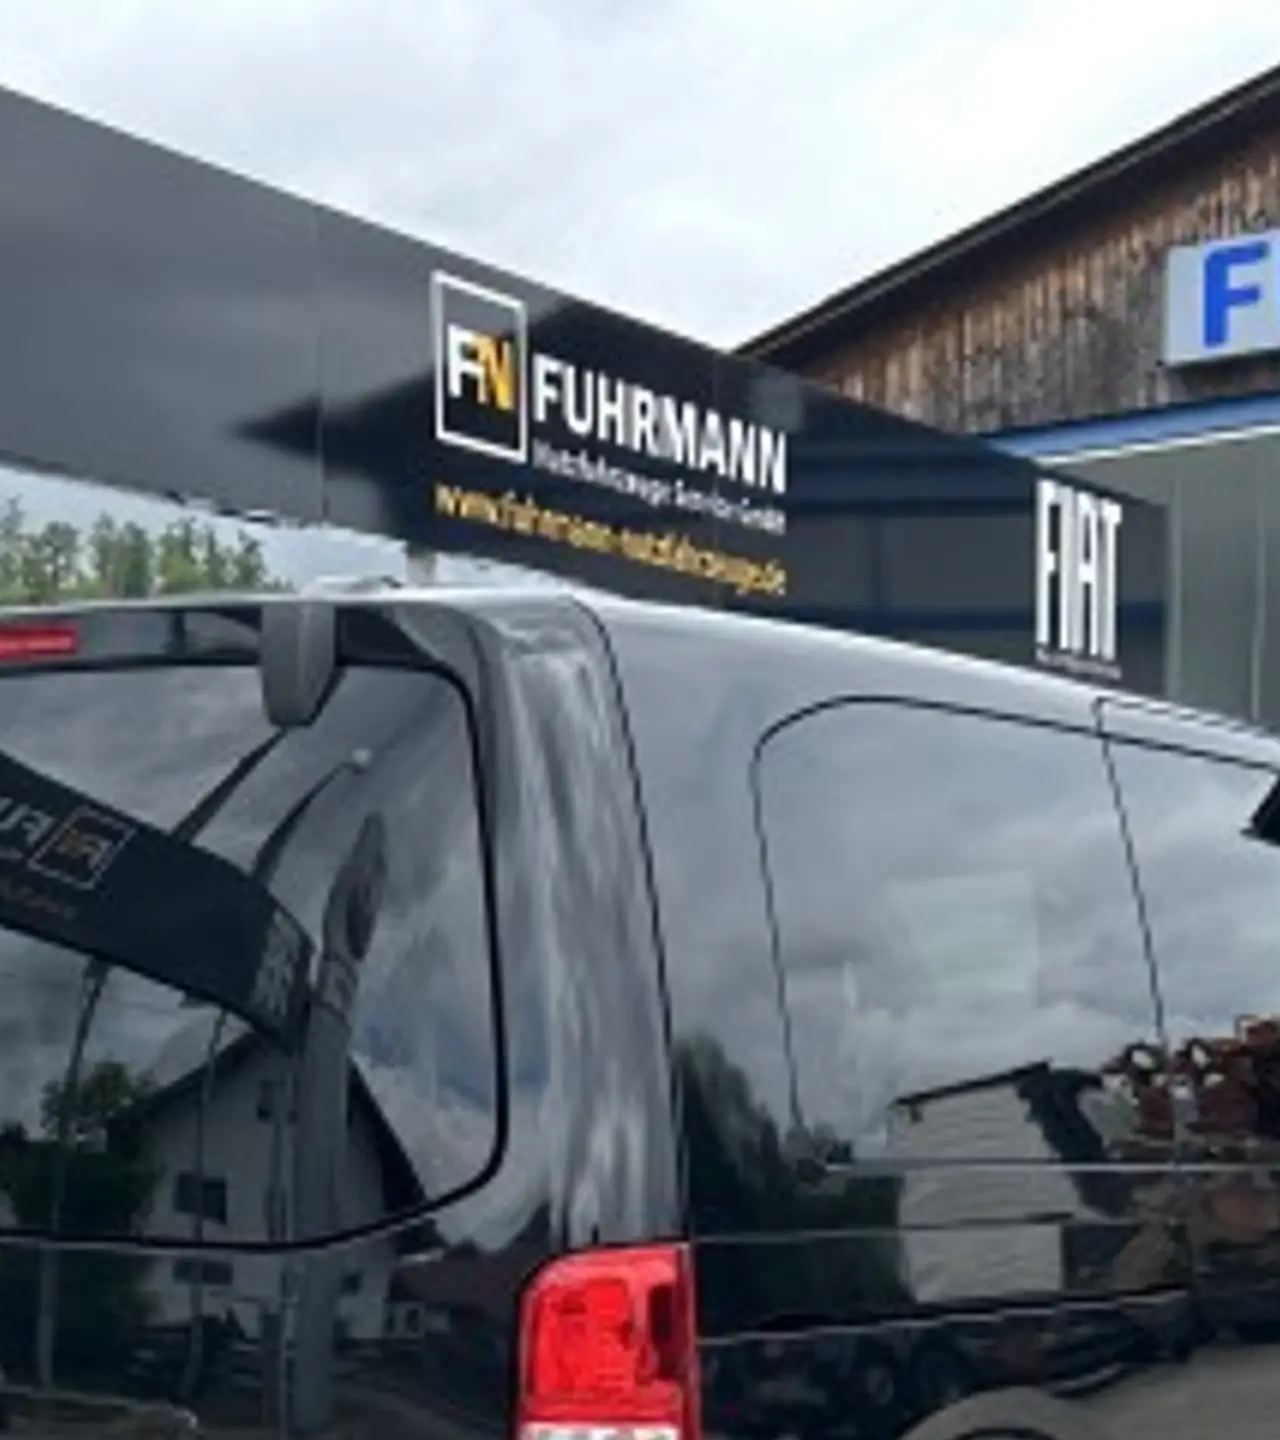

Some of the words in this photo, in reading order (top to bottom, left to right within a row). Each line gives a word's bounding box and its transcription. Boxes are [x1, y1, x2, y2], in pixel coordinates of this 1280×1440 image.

[447, 323, 515, 412] FN
[532, 353, 787, 495] FUHRMANN
[1035, 478, 1123, 662] FIAT
